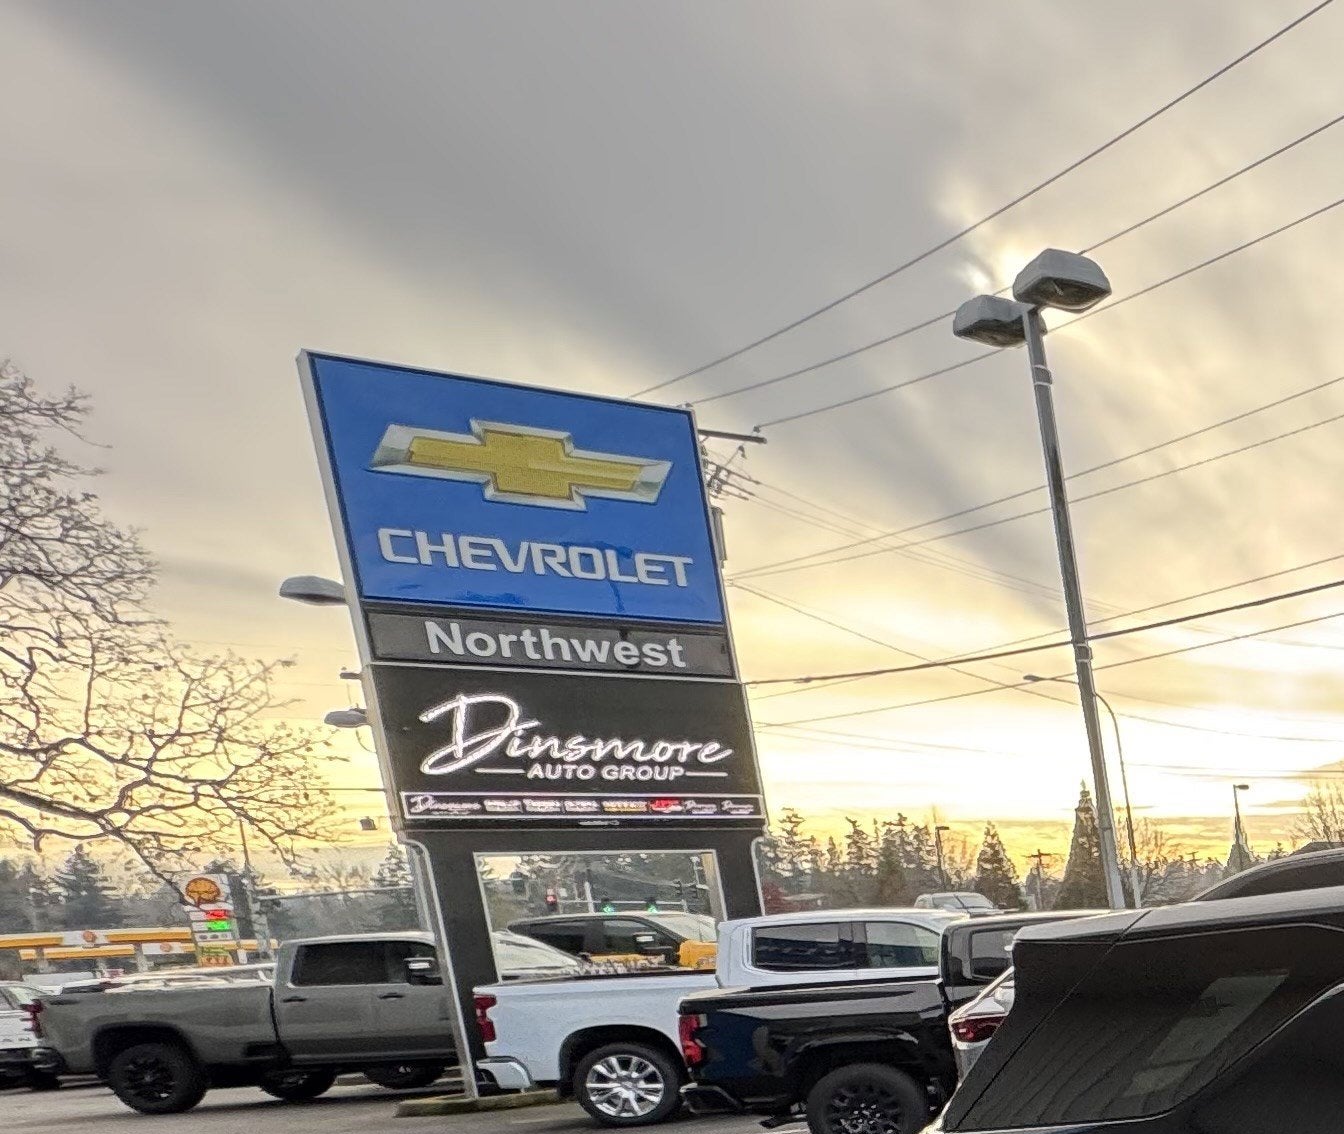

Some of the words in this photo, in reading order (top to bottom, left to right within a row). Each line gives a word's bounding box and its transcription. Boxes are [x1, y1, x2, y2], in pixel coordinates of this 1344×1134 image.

[377, 527, 694, 587] CHEVROLET
[424, 620, 687, 668] Northwest
[418, 693, 733, 775] Dinsmore
[526, 762, 596, 780] AUTO
[600, 763, 685, 781] GROUP
